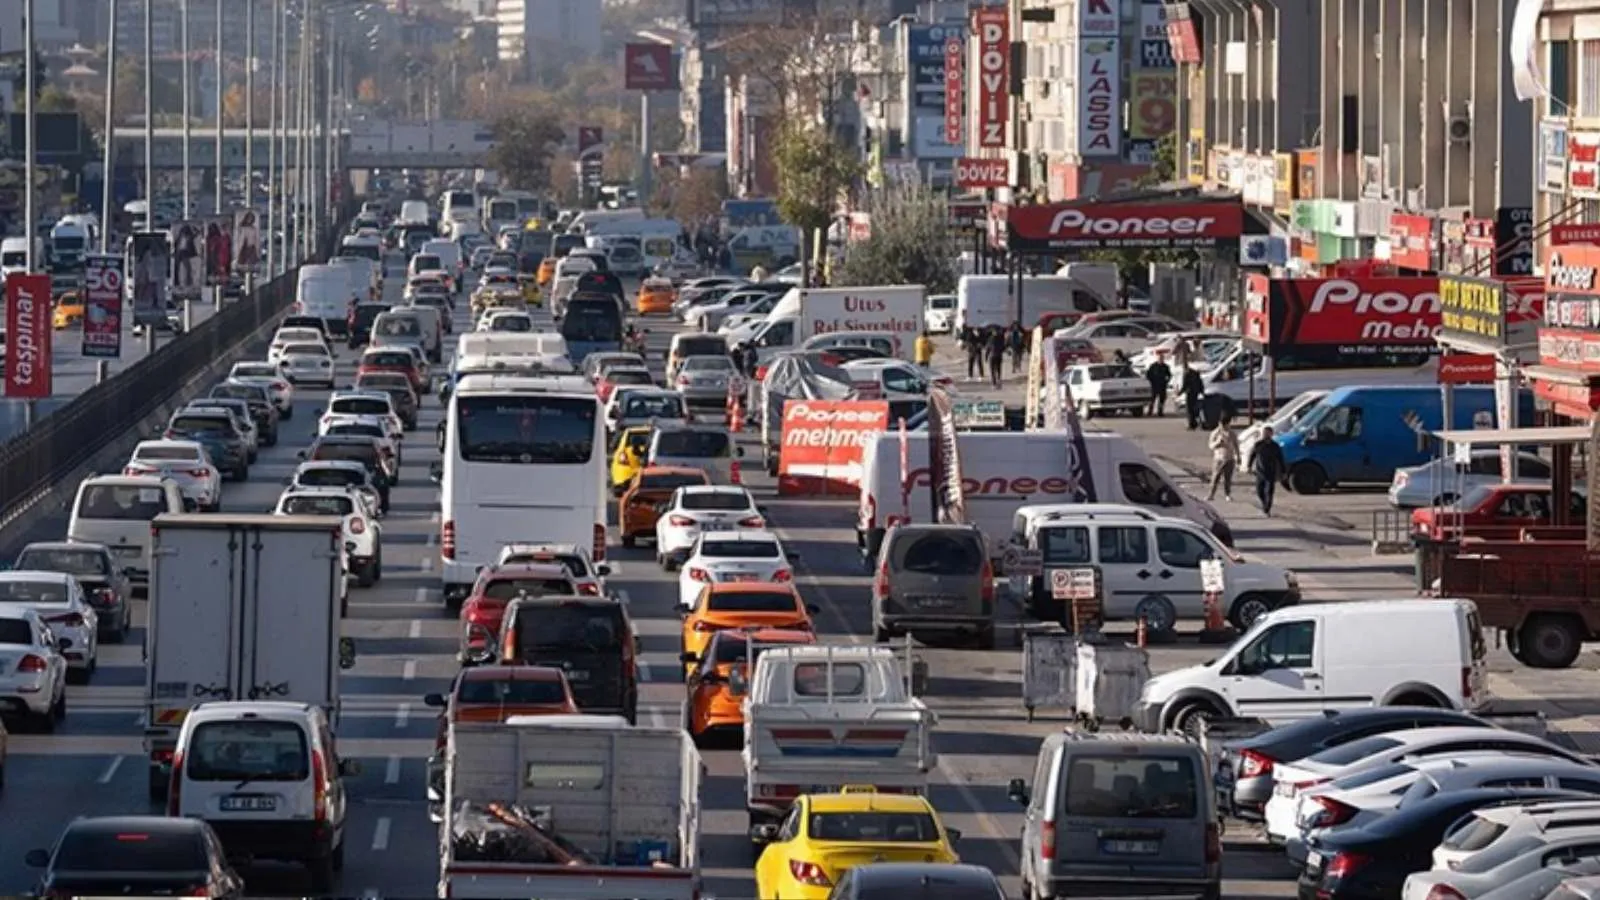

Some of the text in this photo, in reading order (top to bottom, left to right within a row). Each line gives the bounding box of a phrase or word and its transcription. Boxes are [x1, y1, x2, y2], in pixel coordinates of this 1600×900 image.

[948, 43, 959, 139] OTO TEST
[983, 23, 1003, 143] DÖVİZ
[1087, 59, 1111, 149] LASSA
[958, 162, 1006, 182] DÖVİZ
[1050, 210, 1215, 234] Pioneer
[87, 267, 122, 291] 50
[13, 287, 38, 386] taşpınar
[787, 403, 883, 423] Pioneer
